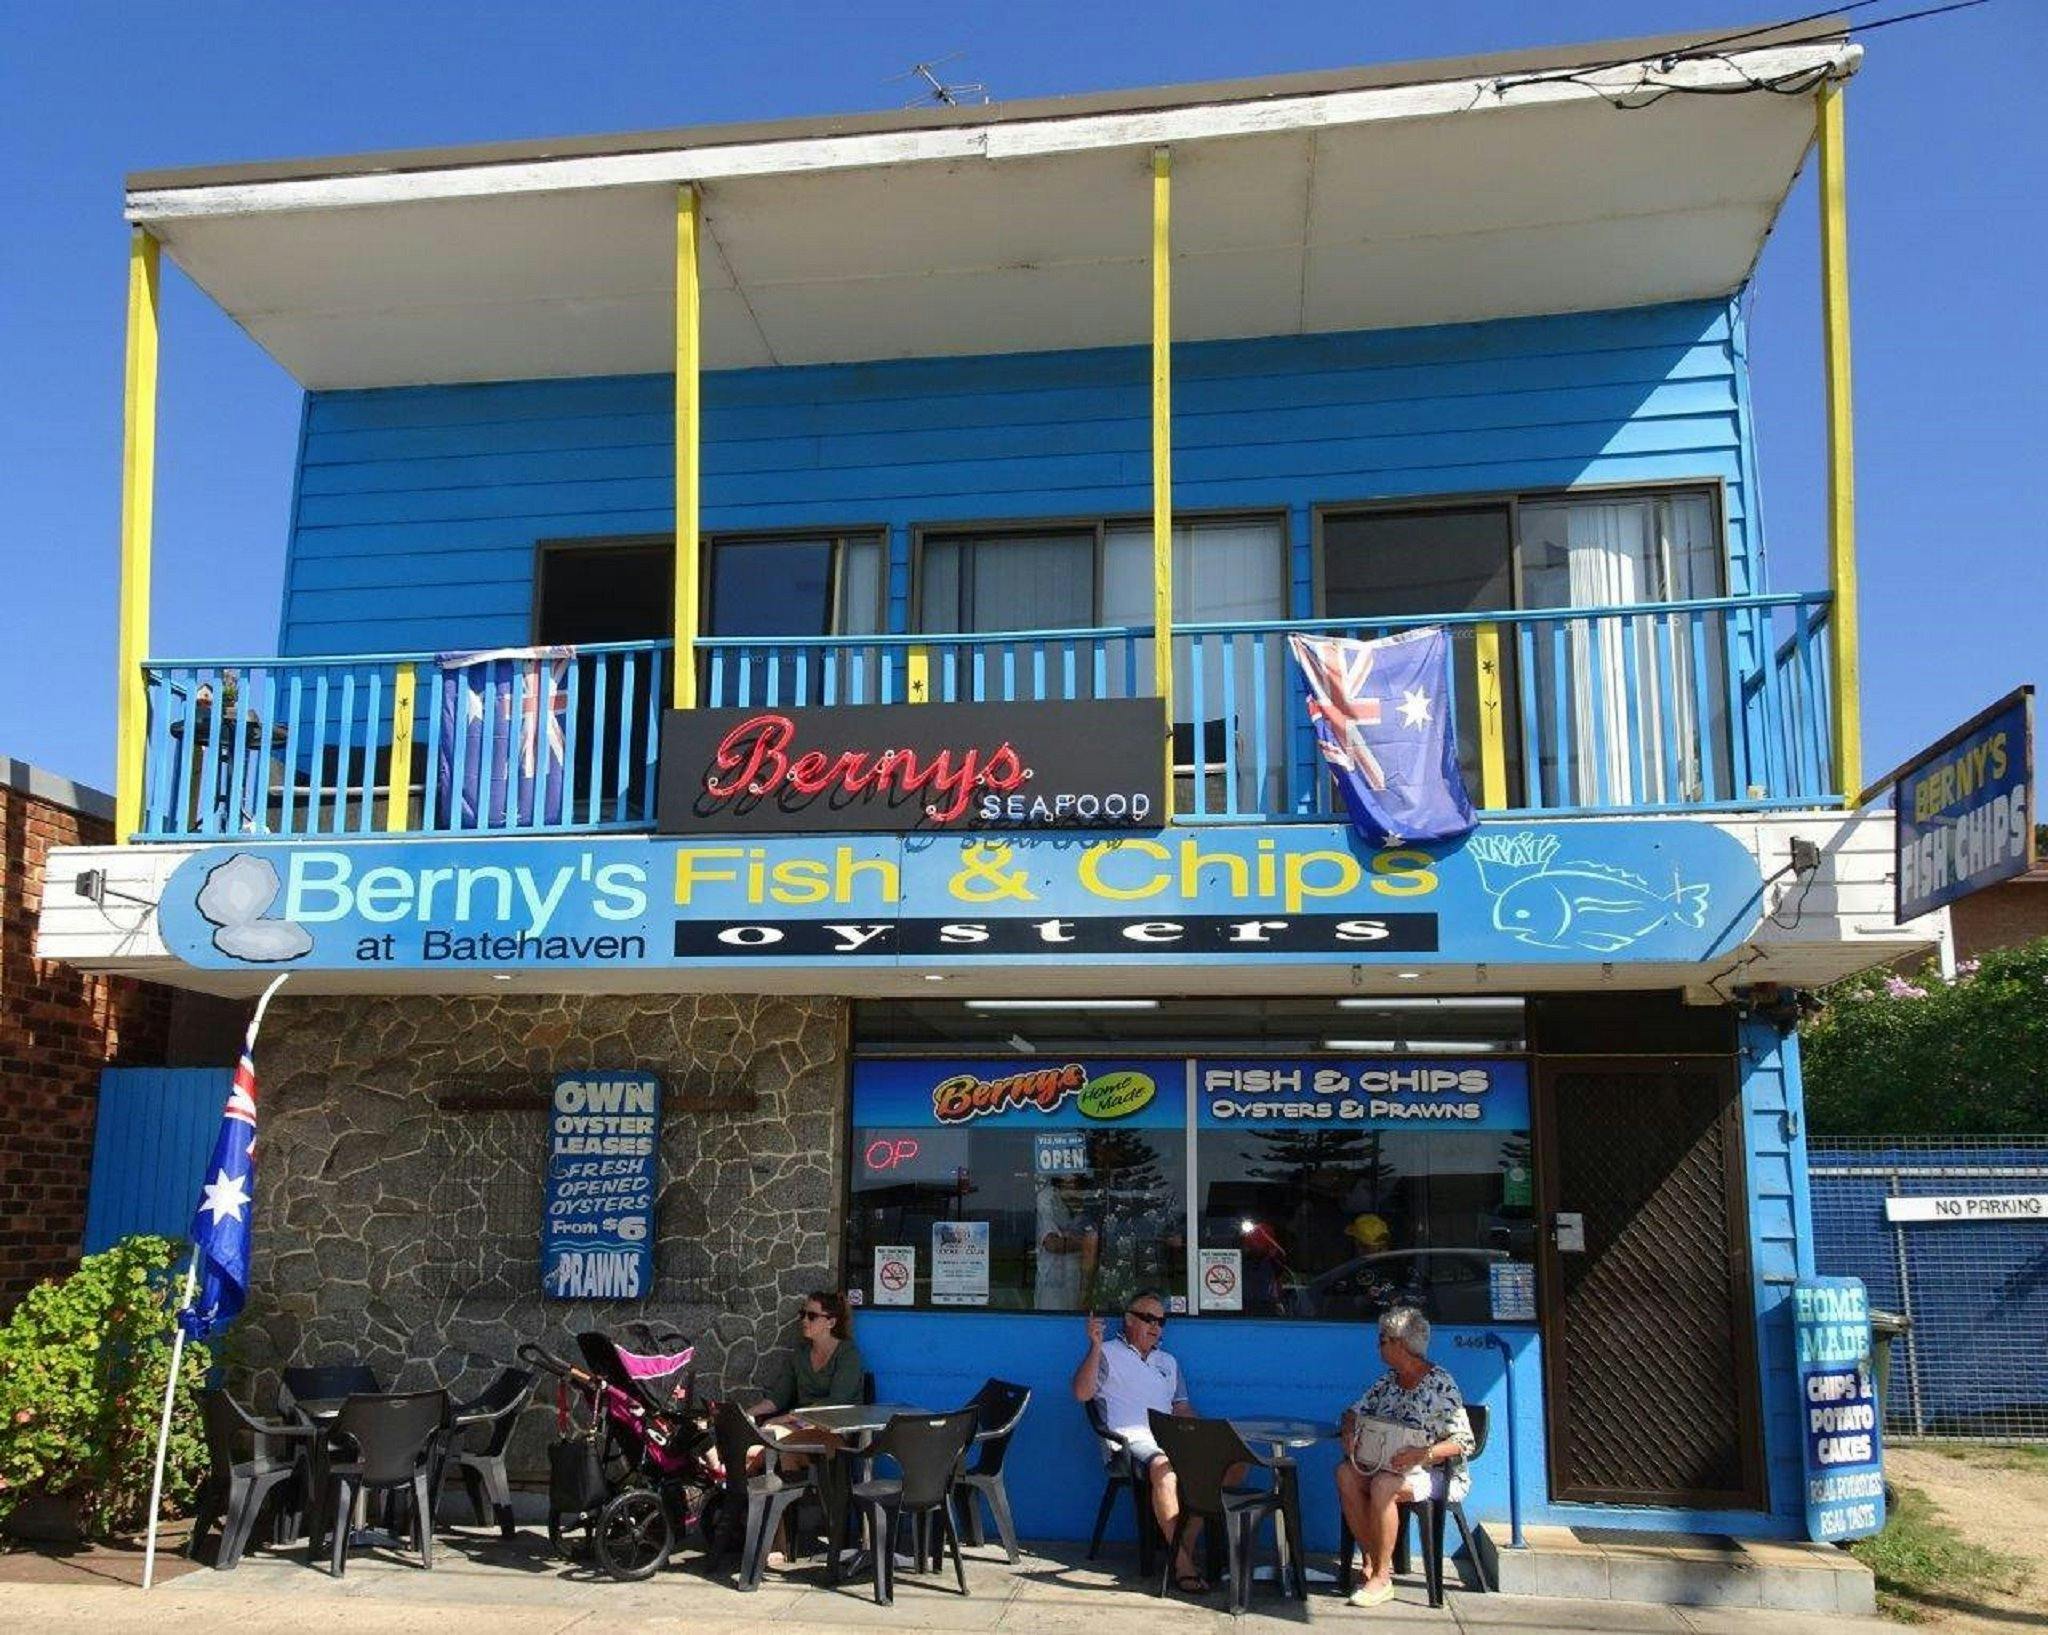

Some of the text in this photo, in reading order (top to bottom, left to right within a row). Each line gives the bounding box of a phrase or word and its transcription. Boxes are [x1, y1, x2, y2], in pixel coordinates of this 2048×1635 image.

[709, 714, 1033, 823] Bernys
[1914, 732, 2007, 824] BERNY'S
[982, 794, 1150, 820] SEAFOOD
[1901, 784, 2026, 905] FISH CHIPS
[284, 836, 1439, 939] Berny's Fish & Chips
[355, 929, 645, 961] at Batehaven
[718, 918, 1390, 951] oysters
[1082, 1077, 1132, 1103] Home
[1204, 1069, 1489, 1093] FISH & CHIPS
[554, 1080, 655, 1113] OWN
[1096, 1087, 1144, 1112] Made
[1339, 1100, 1364, 1119] &
[554, 1116, 654, 1134] OYSTER
[554, 1136, 652, 1155] LEASES
[1040, 1148, 1084, 1169] OPEN
[566, 1158, 645, 1179] FRESH
[558, 1176, 650, 1198] OPENED
[550, 1194, 650, 1215] OYSTERS
[1935, 1198, 2042, 1216] NO PARKING
[552, 1216, 647, 1240] From $6
[557, 1252, 640, 1298] PRAWNS
[1795, 1287, 1865, 1321] HOME
[1802, 1325, 1869, 1362] MADE
[1807, 1371, 1873, 1402] CHIPS &
[1810, 1405, 1874, 1433] POTATO
[1818, 1435, 1871, 1464] CAKES
